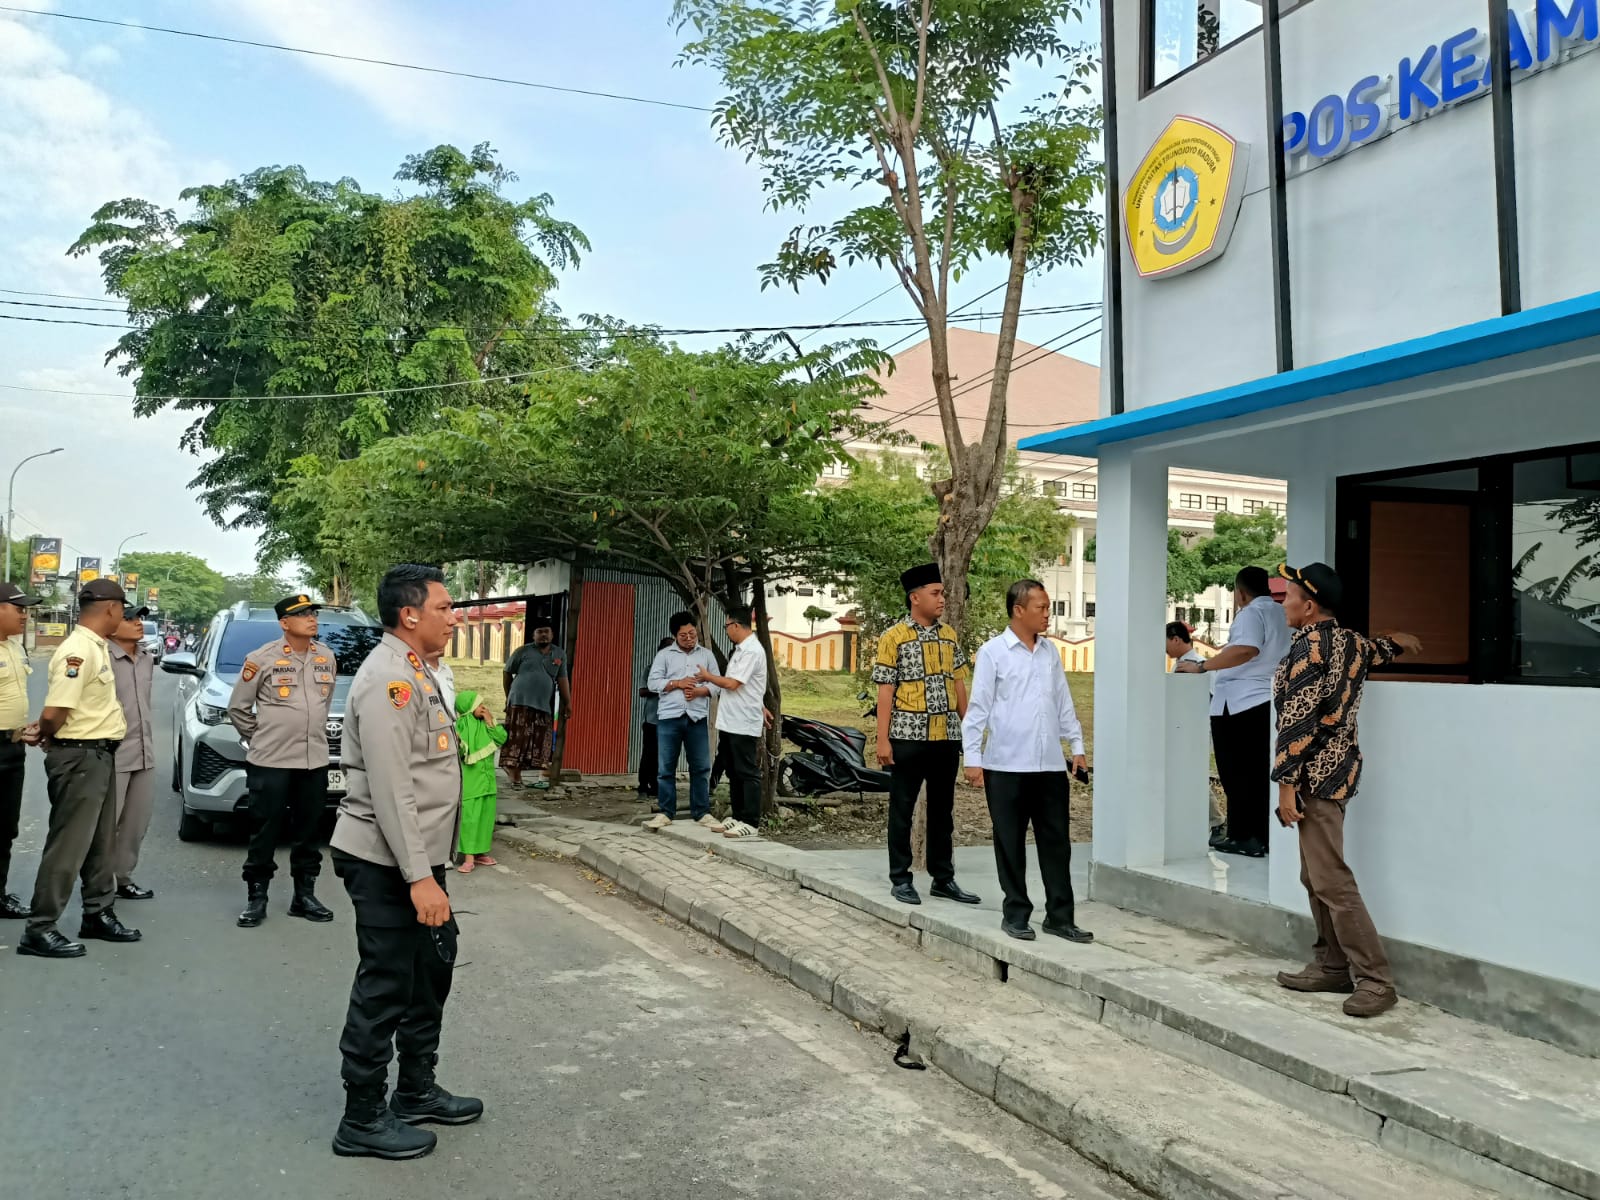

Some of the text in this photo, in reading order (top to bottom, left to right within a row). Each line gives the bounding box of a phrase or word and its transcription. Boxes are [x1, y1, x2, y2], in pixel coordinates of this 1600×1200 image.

[1283, 75, 1381, 158] POS
[1135, 162, 1163, 209] UNIVERSITAS
[1162, 146, 1198, 165] TRUNOJOYO
[1197, 149, 1217, 174] MADURA
